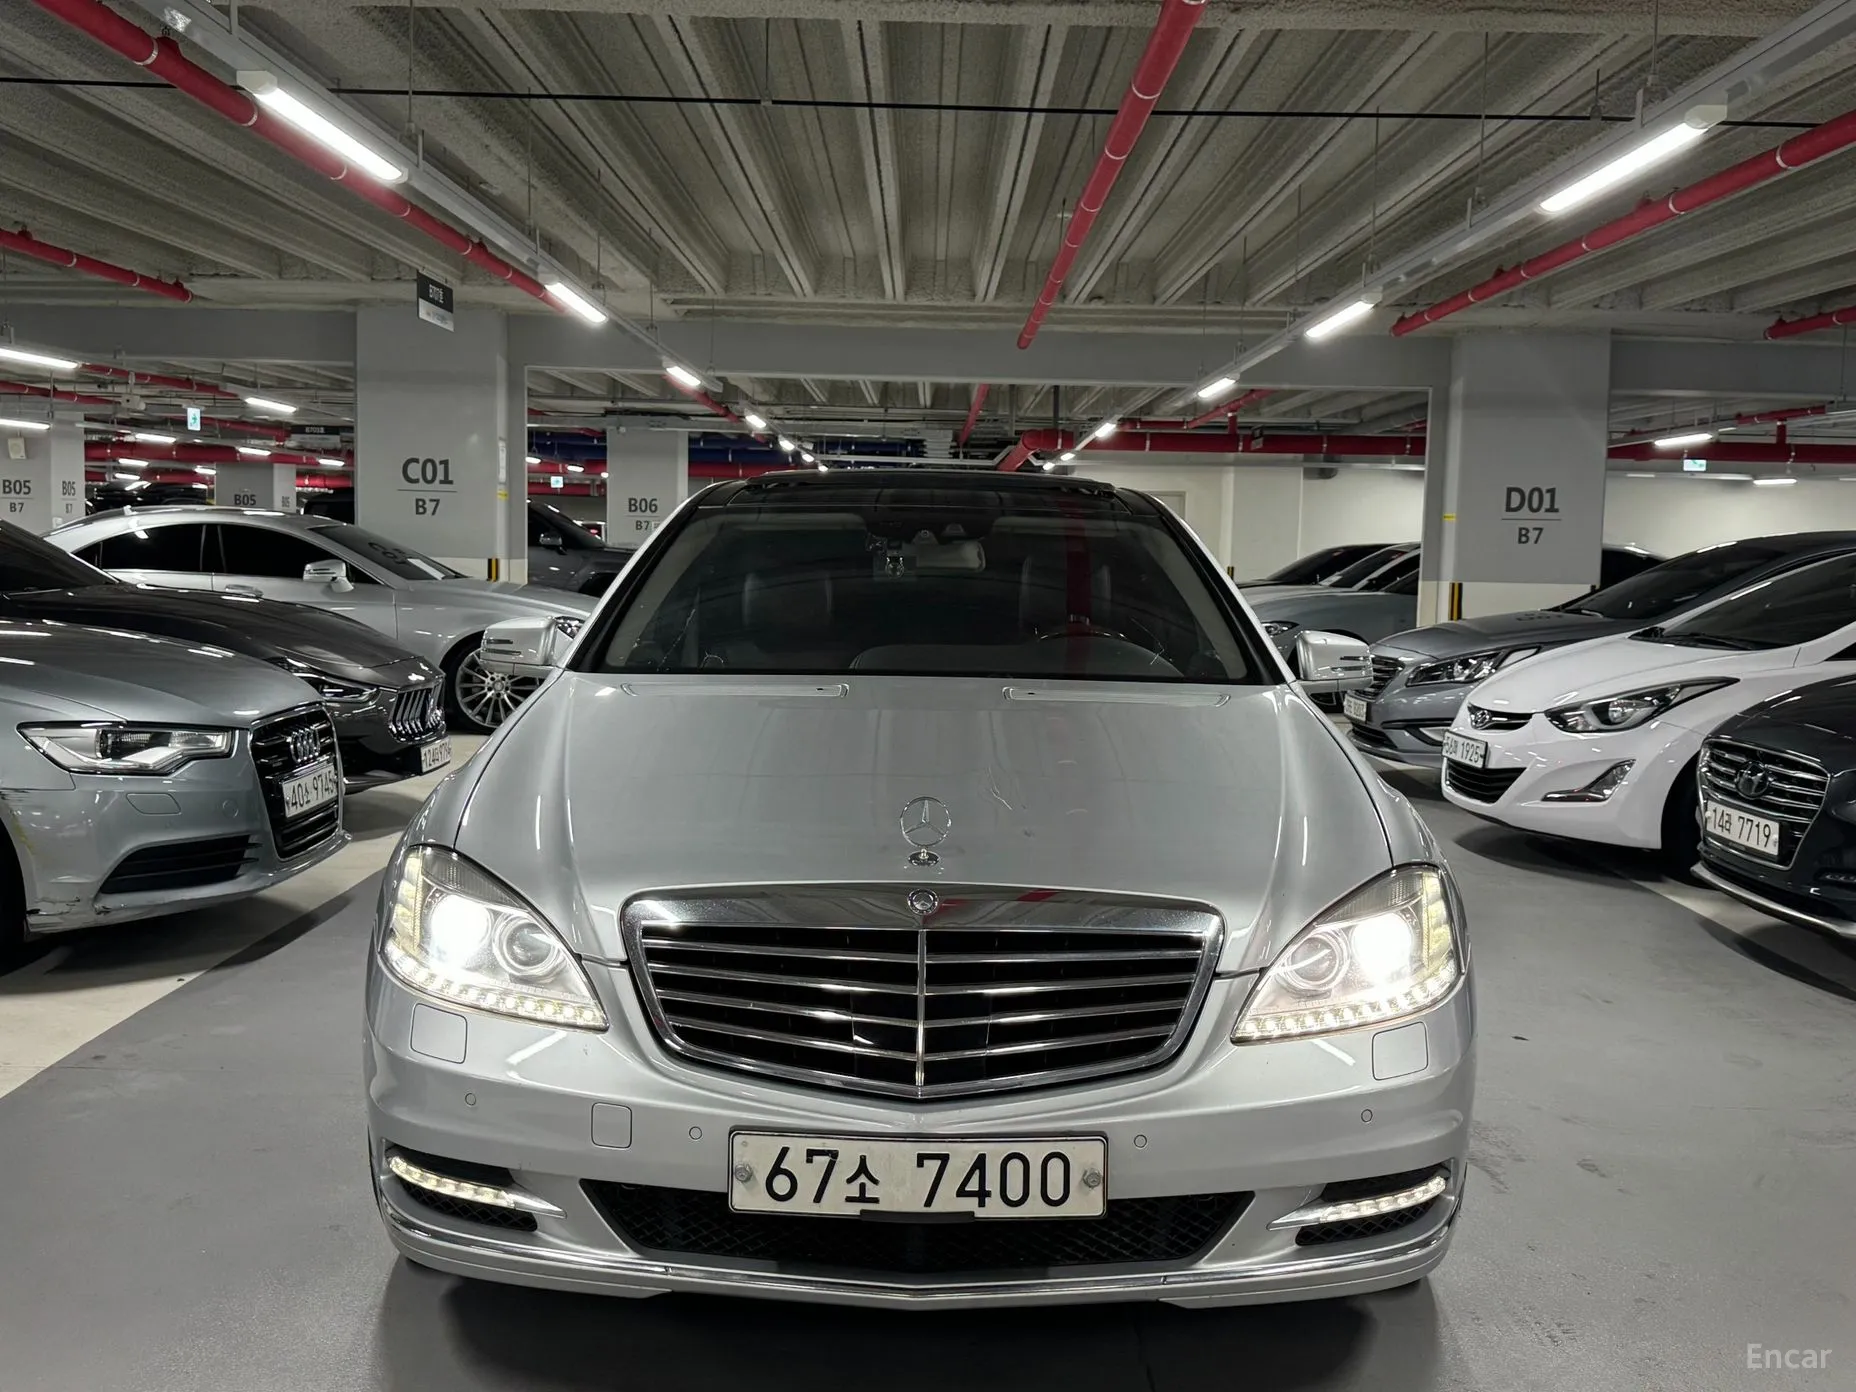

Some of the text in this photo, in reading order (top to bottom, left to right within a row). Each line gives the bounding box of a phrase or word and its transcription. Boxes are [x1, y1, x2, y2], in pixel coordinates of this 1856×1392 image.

[402, 458, 454, 485] C01
[2, 479, 31, 495] B05
[62, 480, 76, 496] B05
[9, 502, 24, 512] B7
[234, 494, 257, 506] B05
[415, 498, 440, 516] B7
[628, 497, 658, 513] B06
[1505, 486, 1560, 513] D01
[635, 520, 650, 531] B7
[1518, 526, 1544, 544] B7
[1461, 740, 1481, 763] 1925
[1738, 815, 1771, 848] 7719
[765, 1146, 1071, 1207] 67소 7400
